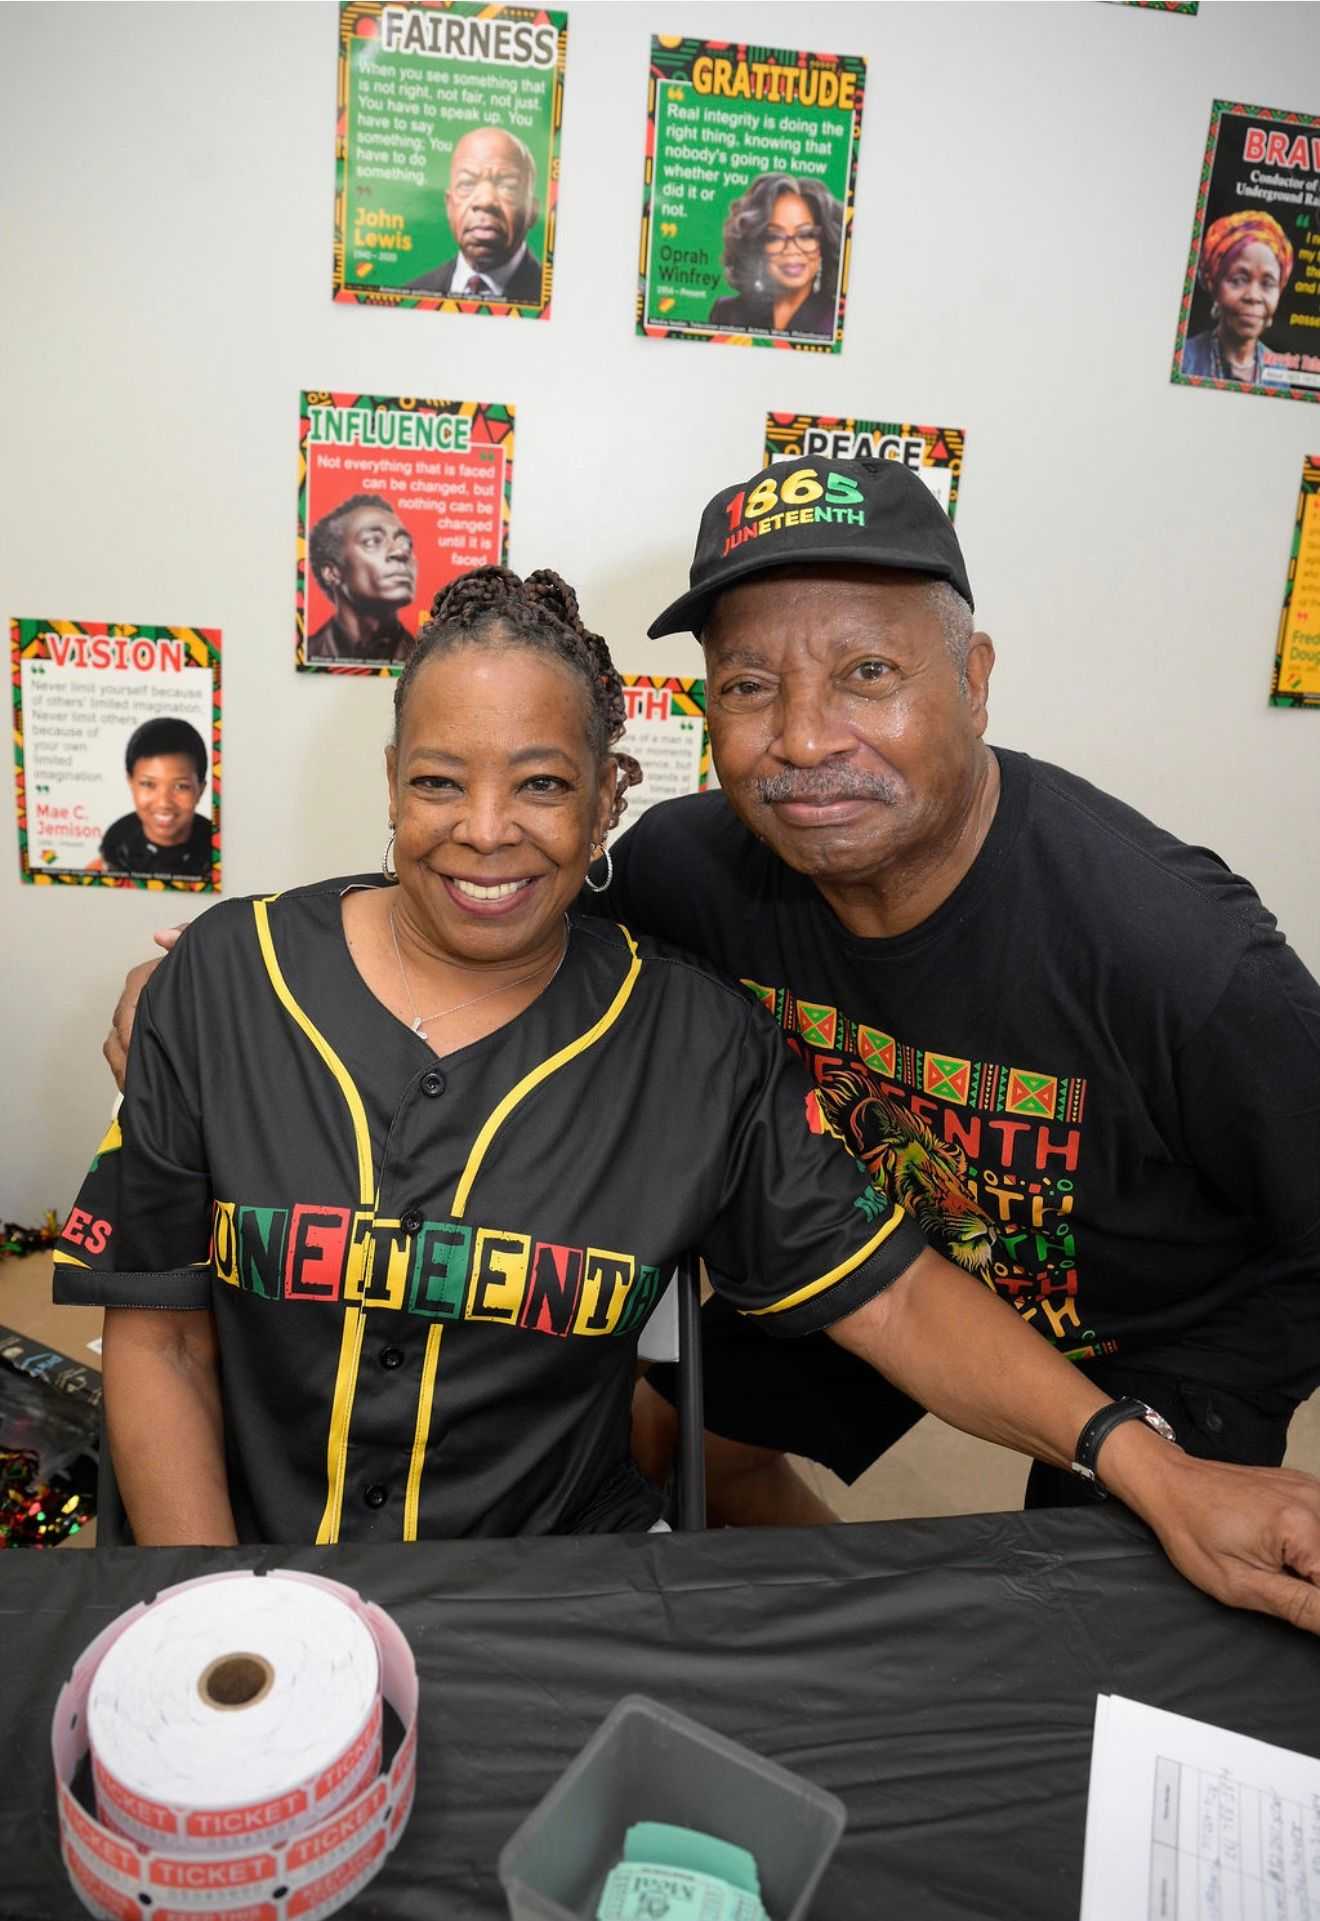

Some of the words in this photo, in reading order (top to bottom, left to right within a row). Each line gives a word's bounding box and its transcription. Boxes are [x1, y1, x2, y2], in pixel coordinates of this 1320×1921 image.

[382, 8, 557, 68] FAIRNESS
[400, 68, 423, 81] you
[426, 70, 449, 84] see
[453, 74, 518, 94] something
[521, 79, 546, 94] that
[692, 56, 857, 110] GRATITUDE
[358, 80, 369, 92] is
[374, 81, 395, 95] not
[437, 88, 458, 102] not
[490, 95, 512, 108] not
[358, 95, 383, 111] You
[387, 99, 419, 115] have
[423, 103, 437, 117] to
[440, 106, 480, 122] speak
[508, 110, 533, 127] You
[667, 102, 700, 121] Real
[704, 107, 760, 131] integrity
[764, 112, 776, 130] is
[779, 116, 818, 138] doing
[822, 121, 844, 137] the
[358, 112, 389, 129] have
[393, 117, 407, 131] to
[411, 121, 434, 137] say
[431, 137, 453, 152] You
[666, 123, 697, 142] right
[744, 132, 801, 155] knowing
[805, 139, 832, 155] that
[357, 146, 388, 163] have
[392, 150, 406, 165] to
[409, 152, 427, 167] do
[664, 144, 727, 166] nobody's
[731, 152, 769, 171] going
[773, 155, 787, 171] to
[790, 156, 828, 174] know
[663, 163, 720, 182] whether
[723, 172, 749, 187] you
[1250, 169, 1305, 190] Conductor
[662, 183, 684, 198] did
[687, 185, 697, 200] it
[700, 189, 715, 201] or
[1235, 181, 1304, 204] Underground
[353, 207, 405, 230] John
[661, 203, 688, 217] not.
[353, 226, 413, 252] Lewis
[660, 245, 709, 265] Oprah
[658, 264, 721, 290] Winfrey
[309, 406, 471, 452] INFLUENCE
[806, 431, 923, 472] PEACE
[316, 453, 341, 469] Not
[344, 458, 413, 476] everything
[415, 460, 441, 475] that
[443, 462, 456, 476] is
[458, 463, 496, 479] faced
[362, 478, 387, 490] can
[389, 477, 407, 491] be
[473, 483, 495, 497] but
[725, 467, 865, 532] 1865
[397, 497, 446, 514] nothing
[449, 501, 474, 513] can
[476, 501, 494, 515] be
[436, 517, 493, 534] changed
[721, 505, 867, 558] JUNETEENTH
[437, 534, 466, 549] until
[468, 535, 478, 549] it
[480, 536, 492, 551] is
[47, 635, 185, 674] VISION
[31, 679, 67, 692] Never
[100, 684, 148, 698] yourself
[151, 685, 203, 699] because
[31, 708, 68, 722] Never
[31, 724, 83, 737] because
[36, 803, 70, 819] Mae
[36, 820, 101, 839] Jemison
[194, 1794, 298, 1834] TICKET
[159, 1857, 268, 1886] TICKET
[297, 1788, 385, 1864] TICKET
